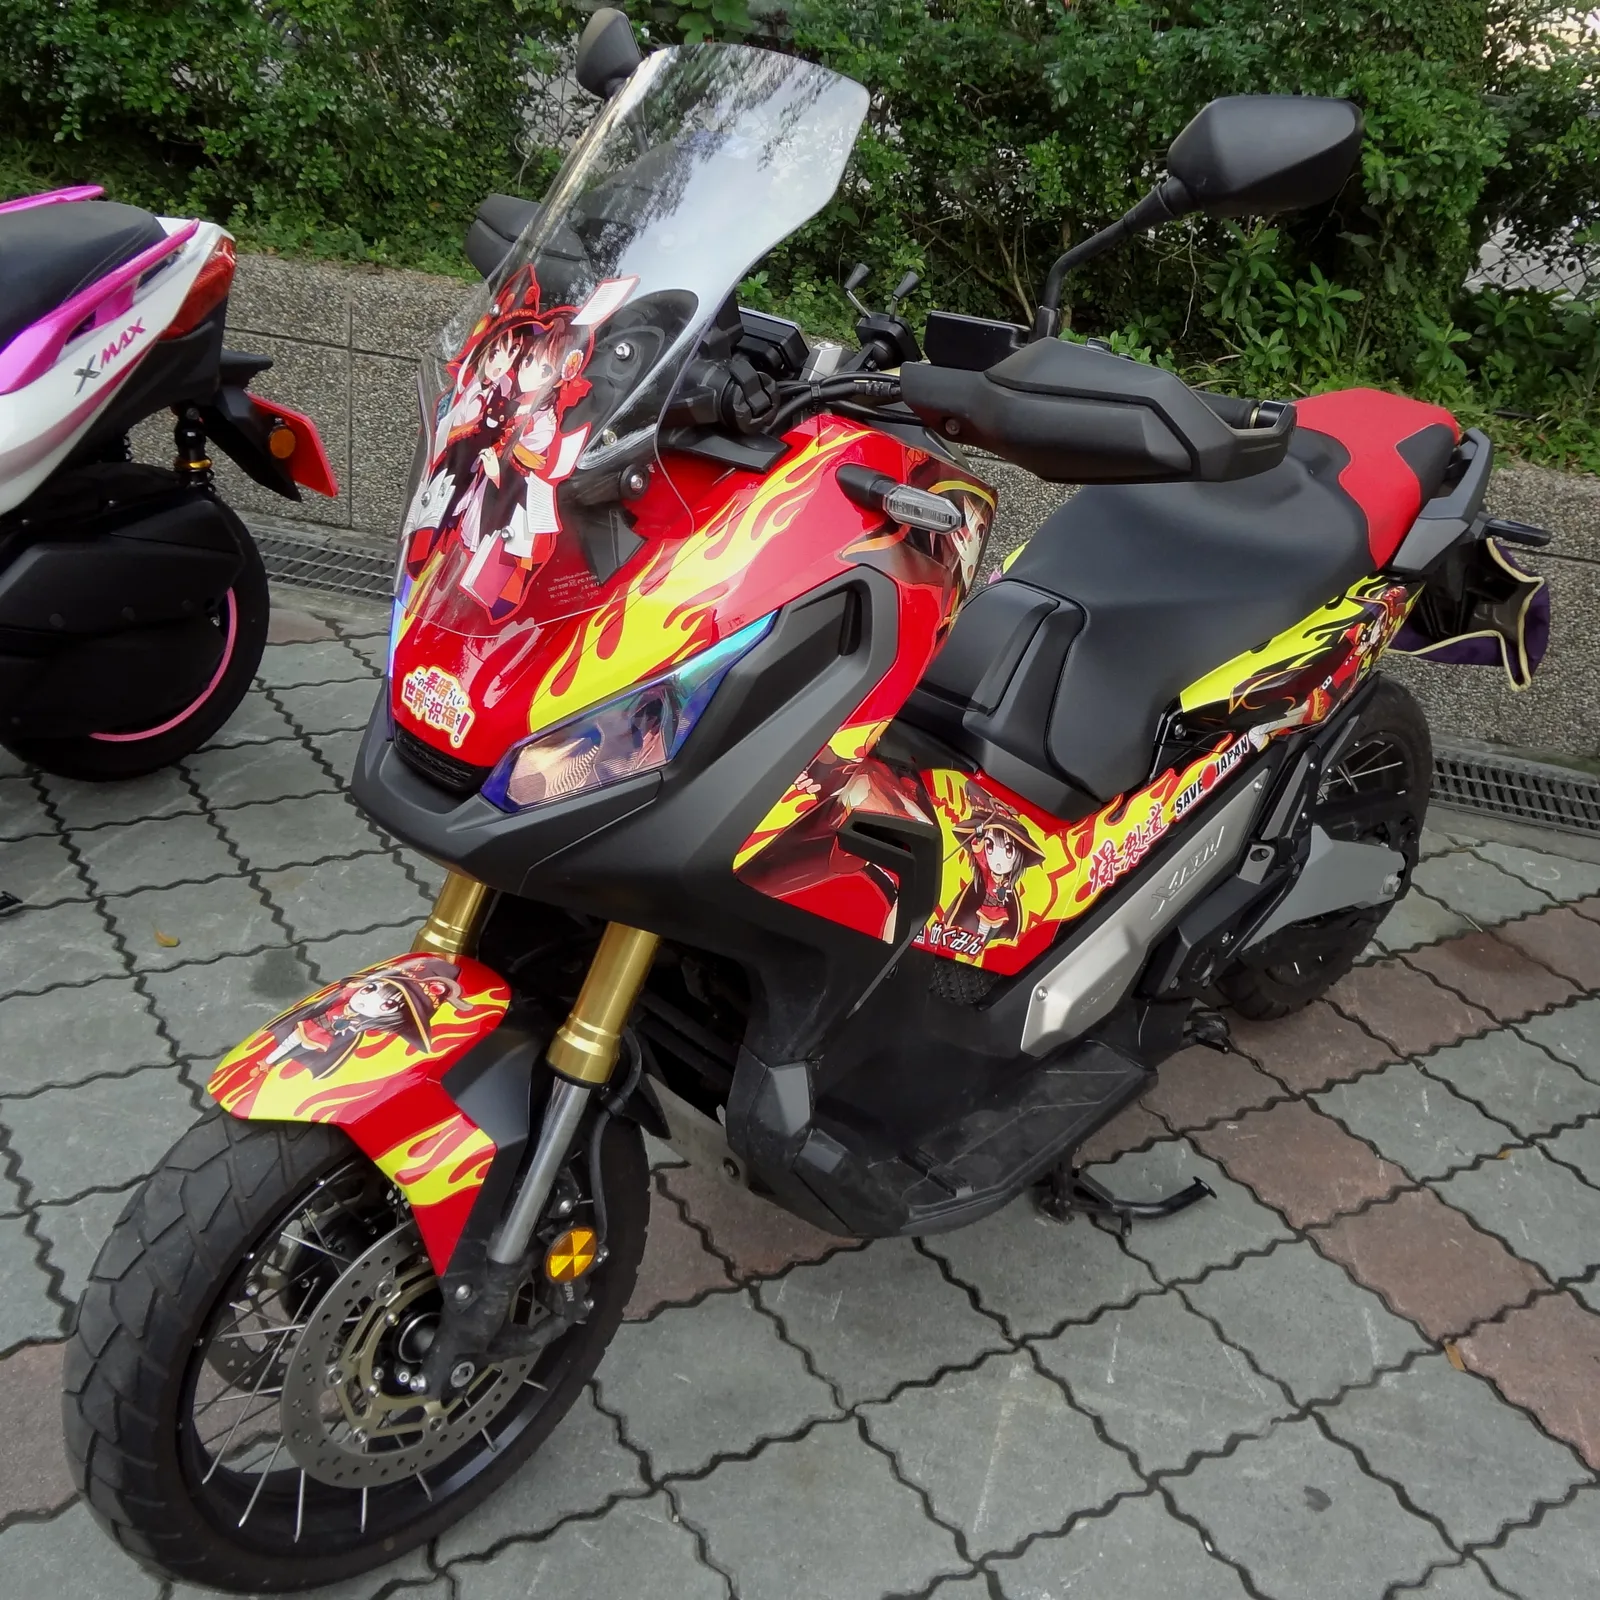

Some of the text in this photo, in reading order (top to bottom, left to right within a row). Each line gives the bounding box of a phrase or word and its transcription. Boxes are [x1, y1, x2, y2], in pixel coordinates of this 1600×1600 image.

[1176, 736, 1249, 814] SAVE JAPAN
[930, 922, 981, 955] めぐみん
